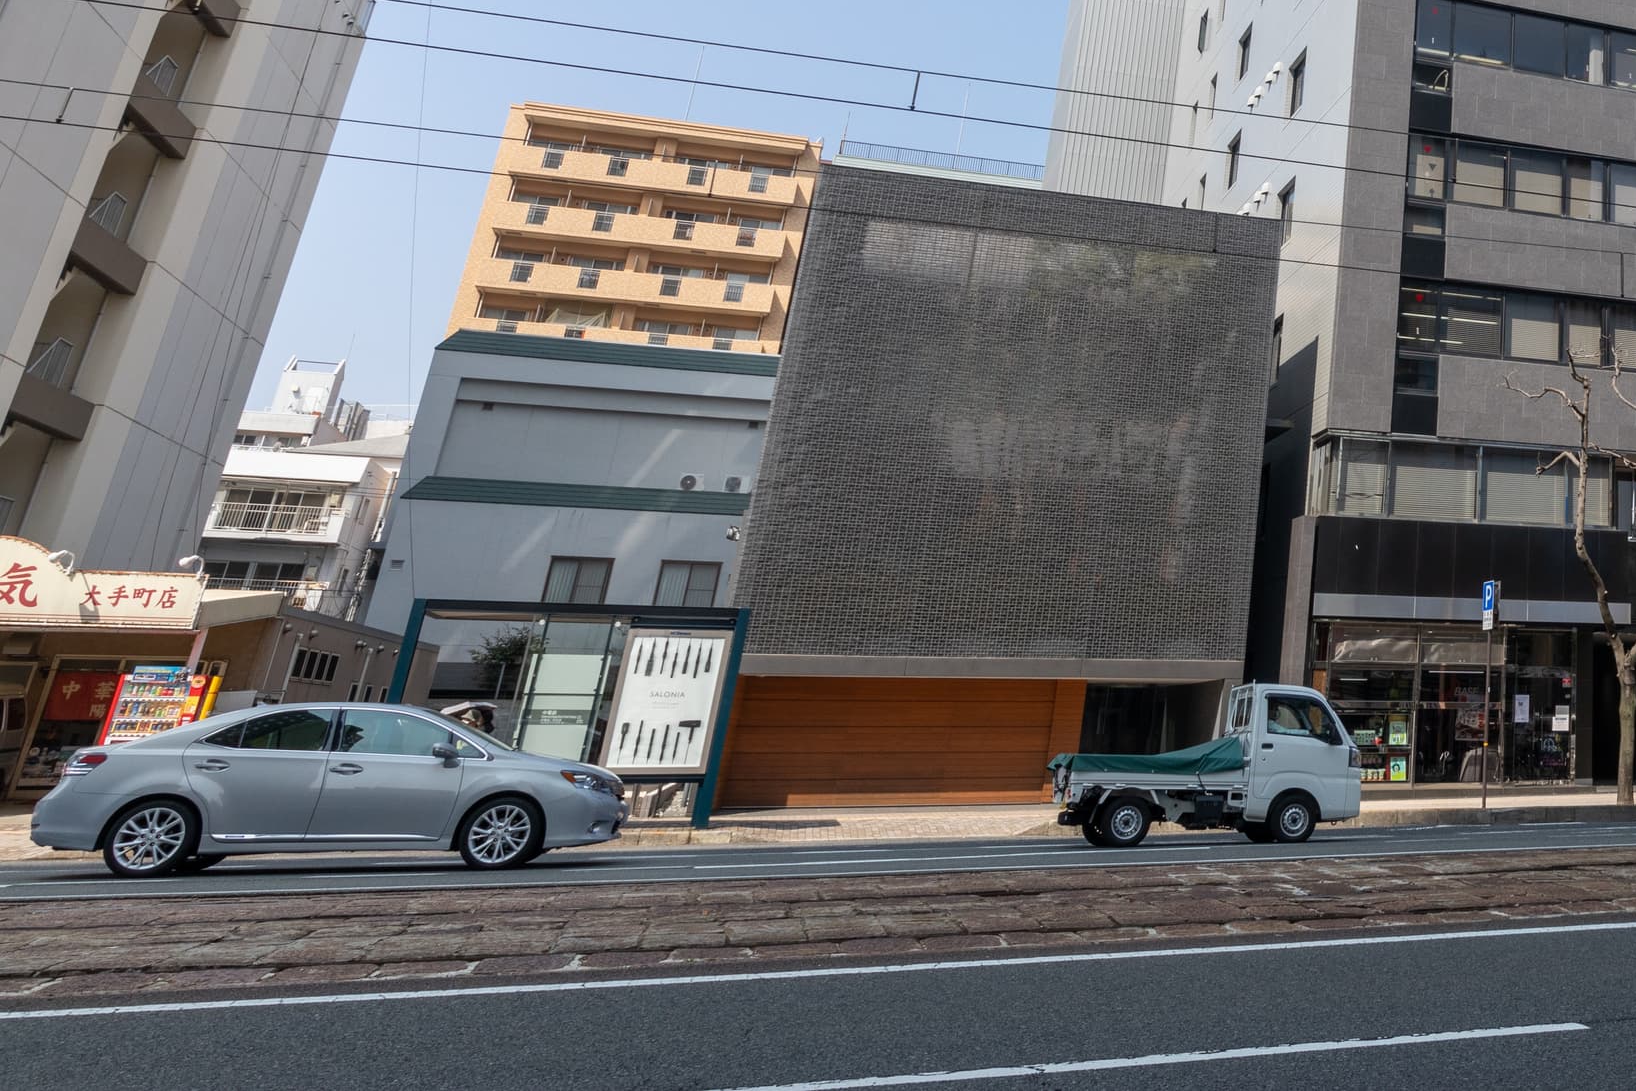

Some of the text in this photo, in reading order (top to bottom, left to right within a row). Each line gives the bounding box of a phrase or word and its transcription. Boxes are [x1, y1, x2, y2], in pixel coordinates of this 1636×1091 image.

[0, 562, 38, 608] 気
[80, 584, 179, 609] 大手町店
[1485, 585, 1492, 609] P
